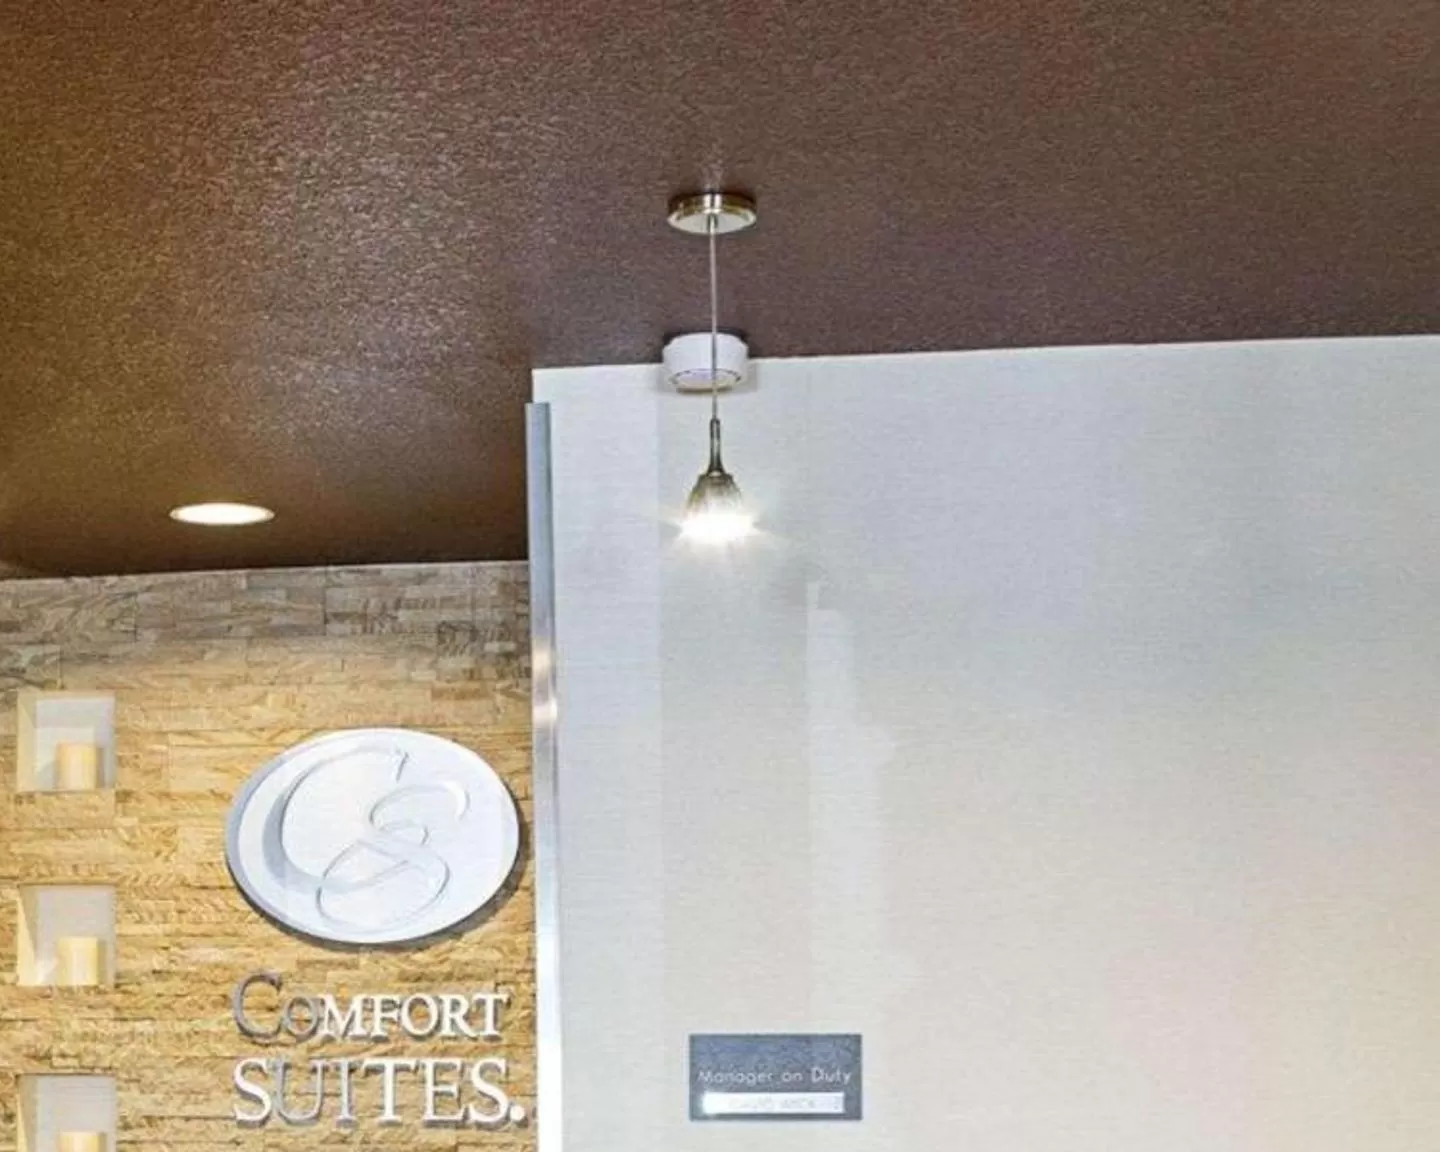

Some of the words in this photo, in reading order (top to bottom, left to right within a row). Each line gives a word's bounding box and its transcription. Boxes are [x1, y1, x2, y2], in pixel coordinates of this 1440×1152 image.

[233, 972, 511, 1045] COMFORT
[698, 1069, 773, 1086] Manager
[781, 1072, 803, 1083] on
[811, 1066, 853, 1085] Duty
